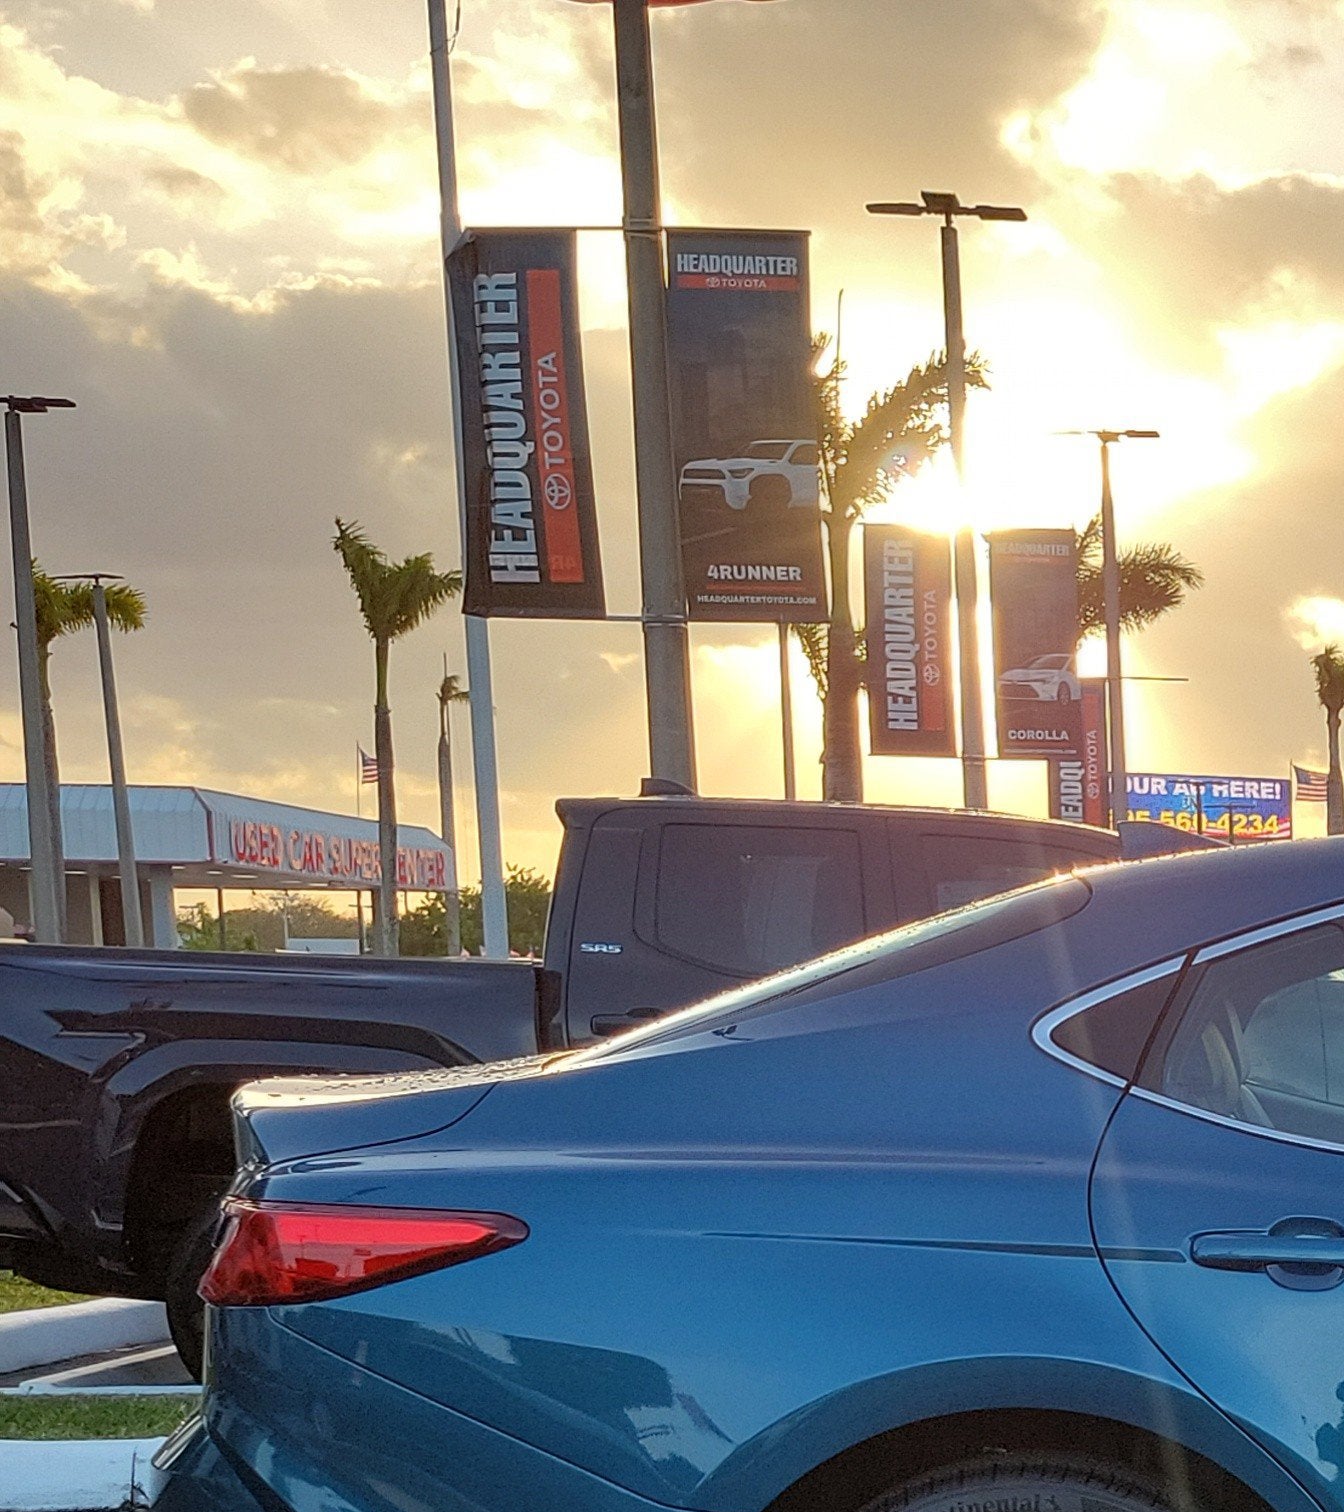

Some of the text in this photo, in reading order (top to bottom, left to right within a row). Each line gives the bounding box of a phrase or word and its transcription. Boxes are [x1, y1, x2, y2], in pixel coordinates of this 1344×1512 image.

[676, 253, 798, 276] HEADQUARTER
[721, 279, 767, 289] TOYOTA
[473, 271, 541, 583] HEADQUARTER
[537, 351, 566, 469] TOYOTA
[707, 564, 802, 580] 4RUNNER
[884, 538, 920, 731] HEADQUARTER
[924, 589, 938, 662] TOYOTA
[1008, 729, 1070, 741] COROLLA
[1086, 730, 1098, 781] TOYOTA
[1212, 779, 1282, 801] HERE!
[231, 819, 285, 867] USED
[289, 830, 325, 873] CAR
[397, 847, 445, 887] ENTER
[580, 943, 622, 954] SR5
